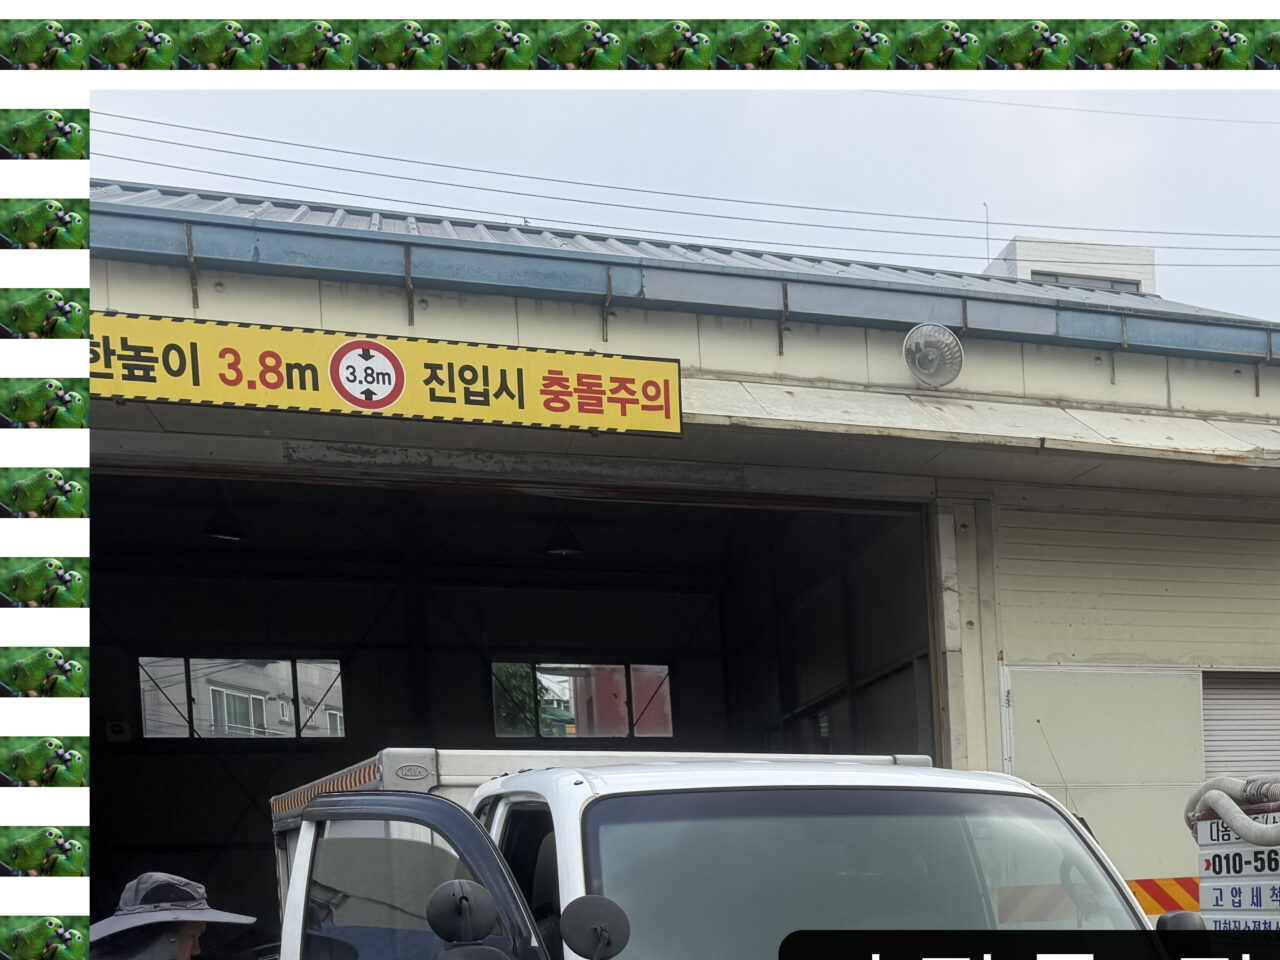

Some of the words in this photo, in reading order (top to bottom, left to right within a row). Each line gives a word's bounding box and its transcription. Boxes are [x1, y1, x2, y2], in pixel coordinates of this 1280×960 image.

[218, 347, 319, 392] 3.8m
[345, 364, 392, 387] 3.8m
[422, 361, 525, 410] 진입시
[539, 369, 672, 420] 충돌주의
